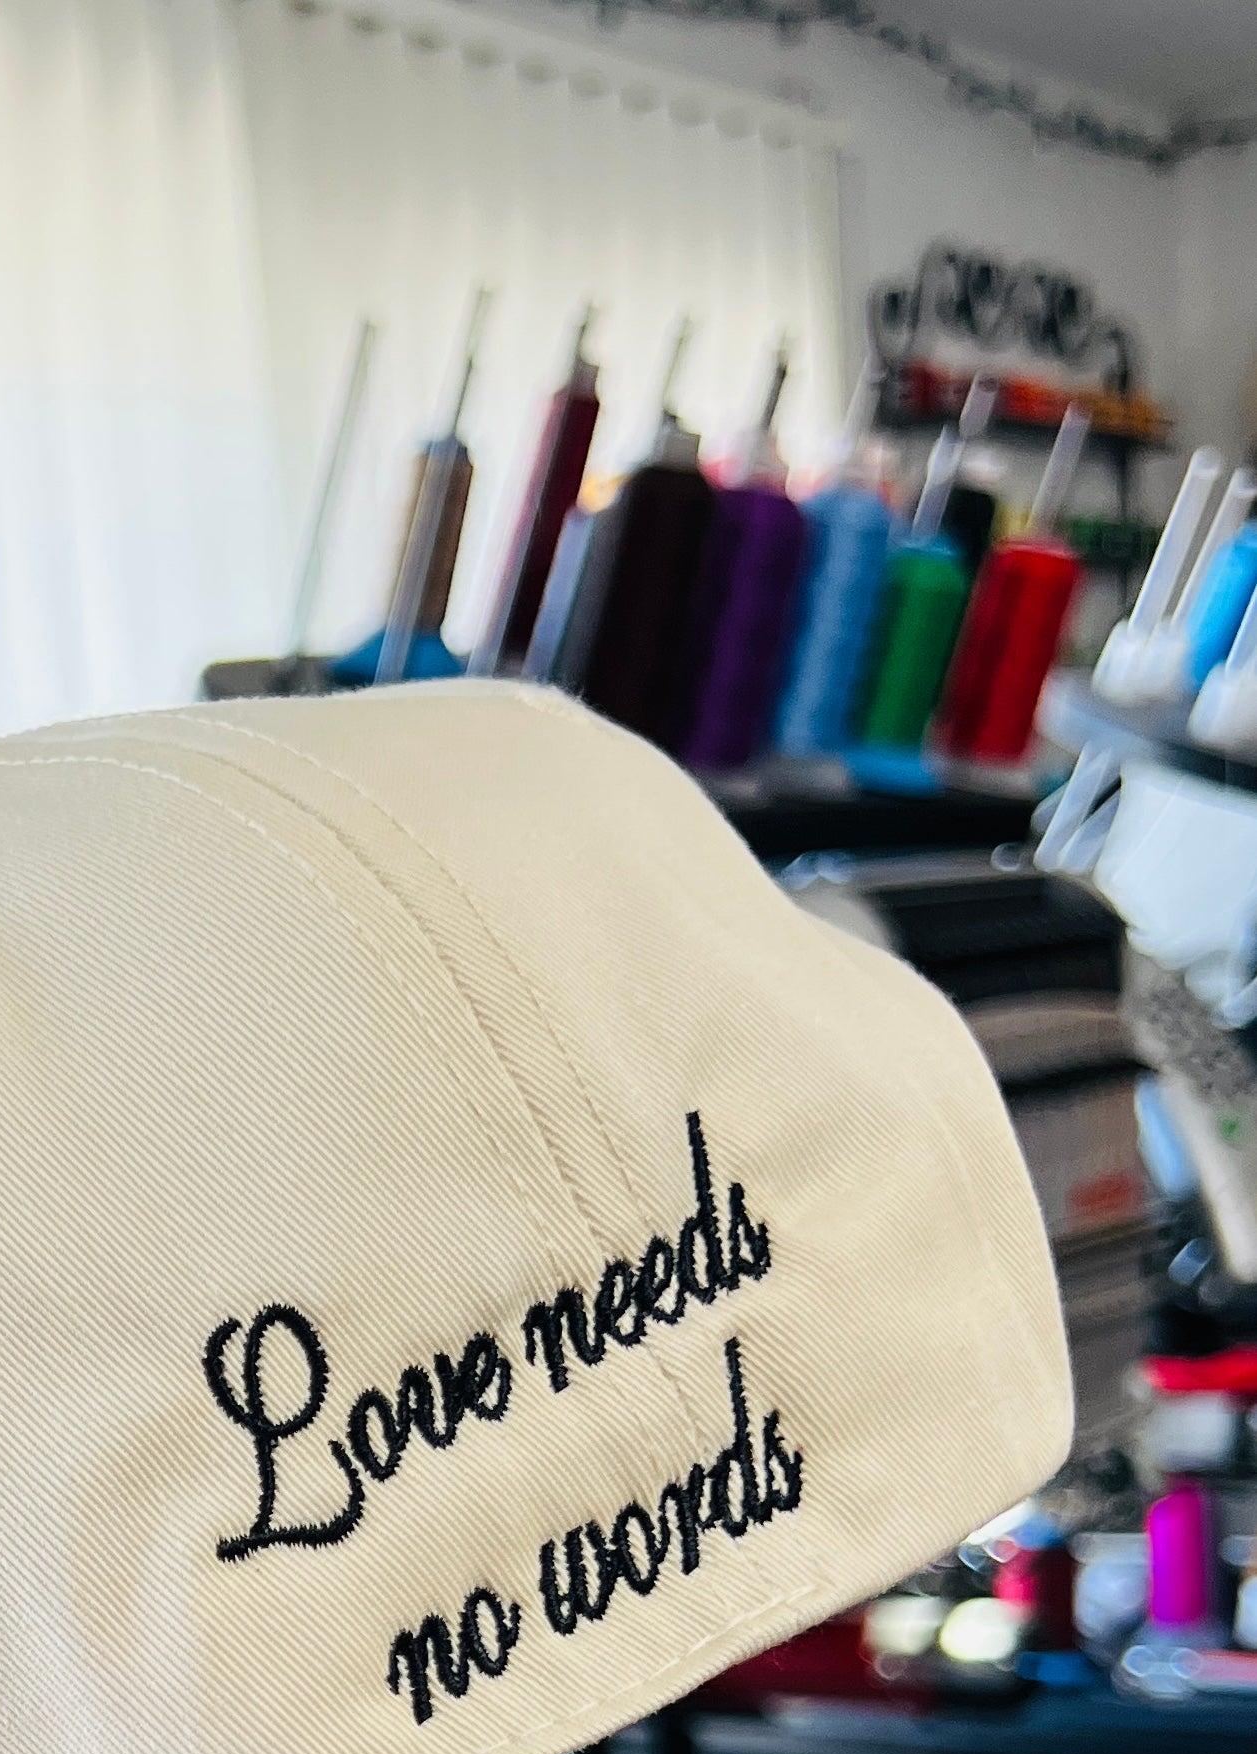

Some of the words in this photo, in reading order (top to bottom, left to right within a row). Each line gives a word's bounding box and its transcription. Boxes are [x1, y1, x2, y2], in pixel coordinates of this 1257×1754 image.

[202, 1302, 513, 1564] Love
[520, 1110, 772, 1394] needs
[386, 1586, 522, 1726] no
[538, 1336, 804, 1637] words
